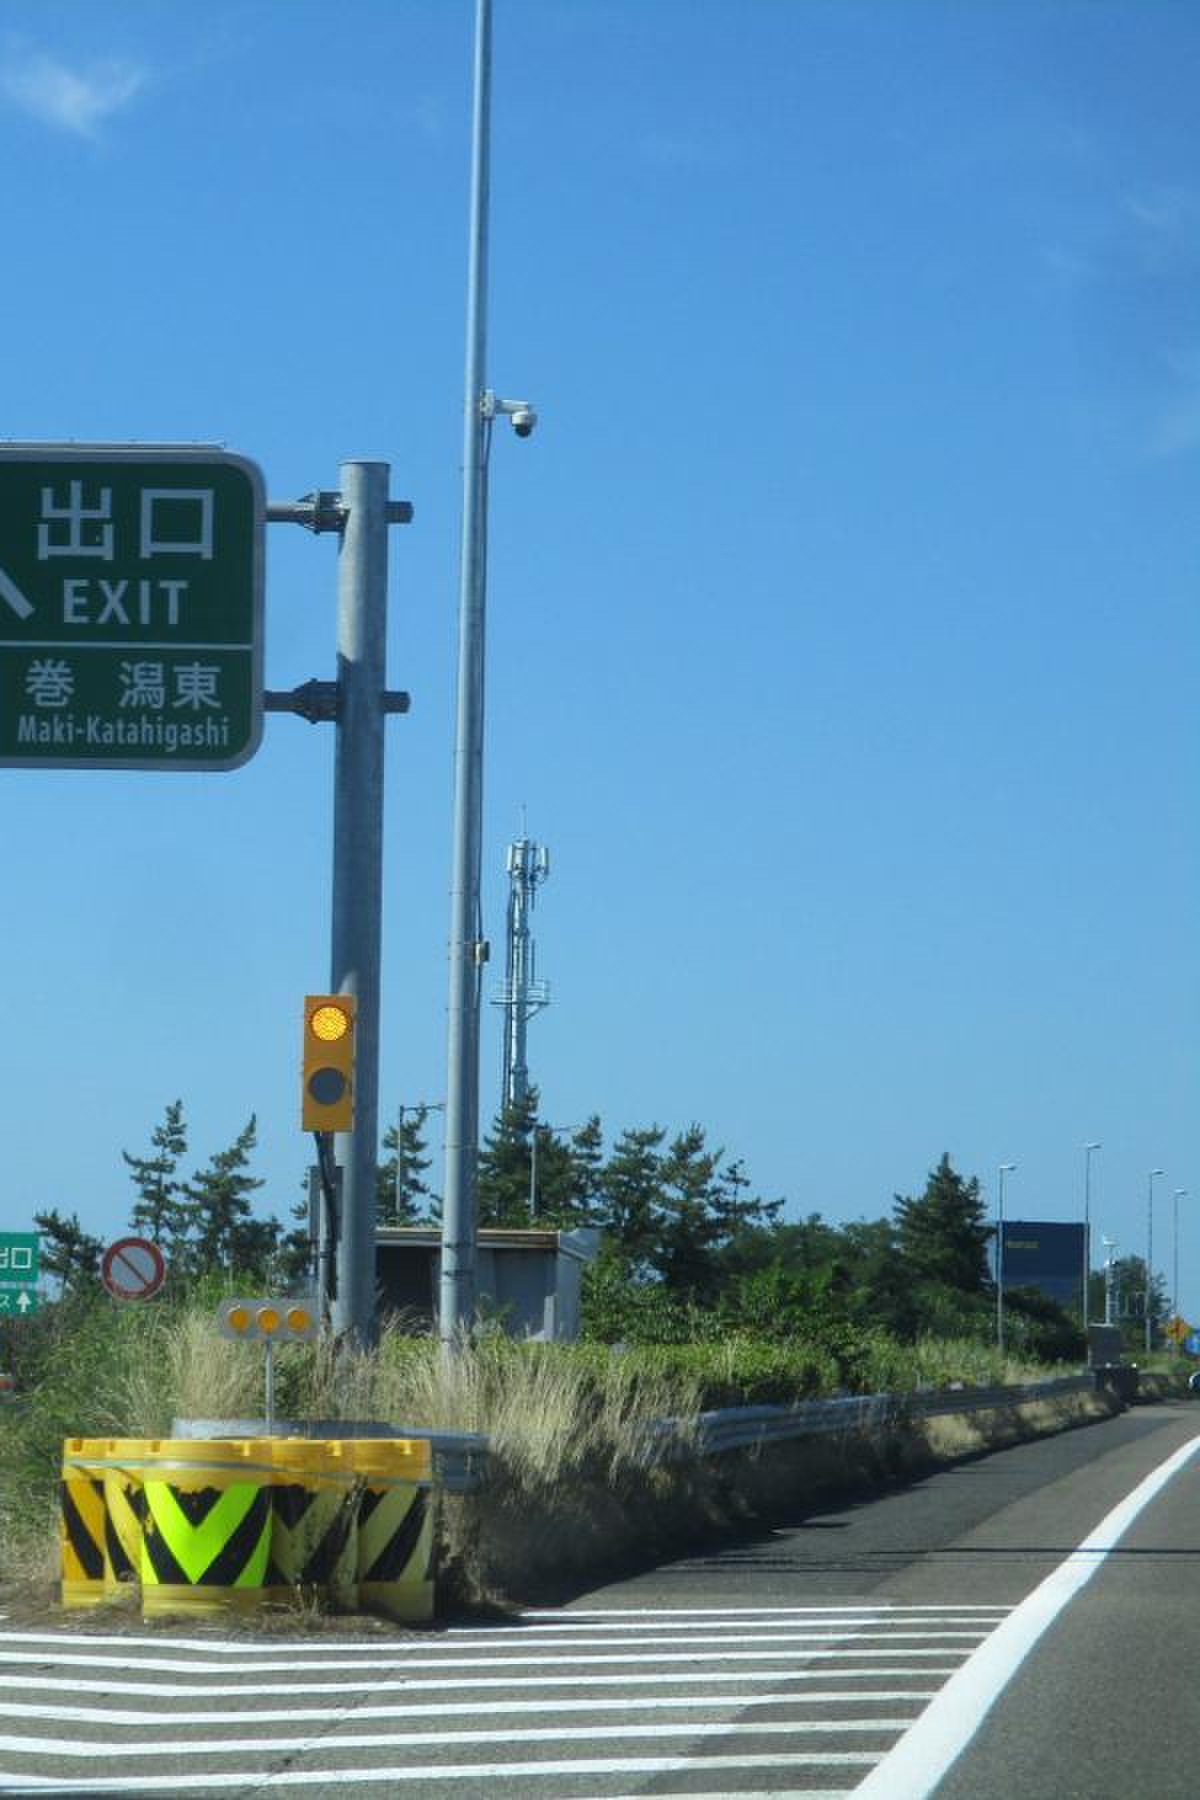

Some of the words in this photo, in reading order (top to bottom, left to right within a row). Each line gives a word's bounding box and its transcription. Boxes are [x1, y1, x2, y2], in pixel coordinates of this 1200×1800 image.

[37, 480, 214, 560] 出口
[63, 579, 188, 625] EXIT
[26, 659, 75, 708] 巻
[118, 661, 222, 711] 潟東
[17, 714, 230, 753] Maki-Katahigashi
